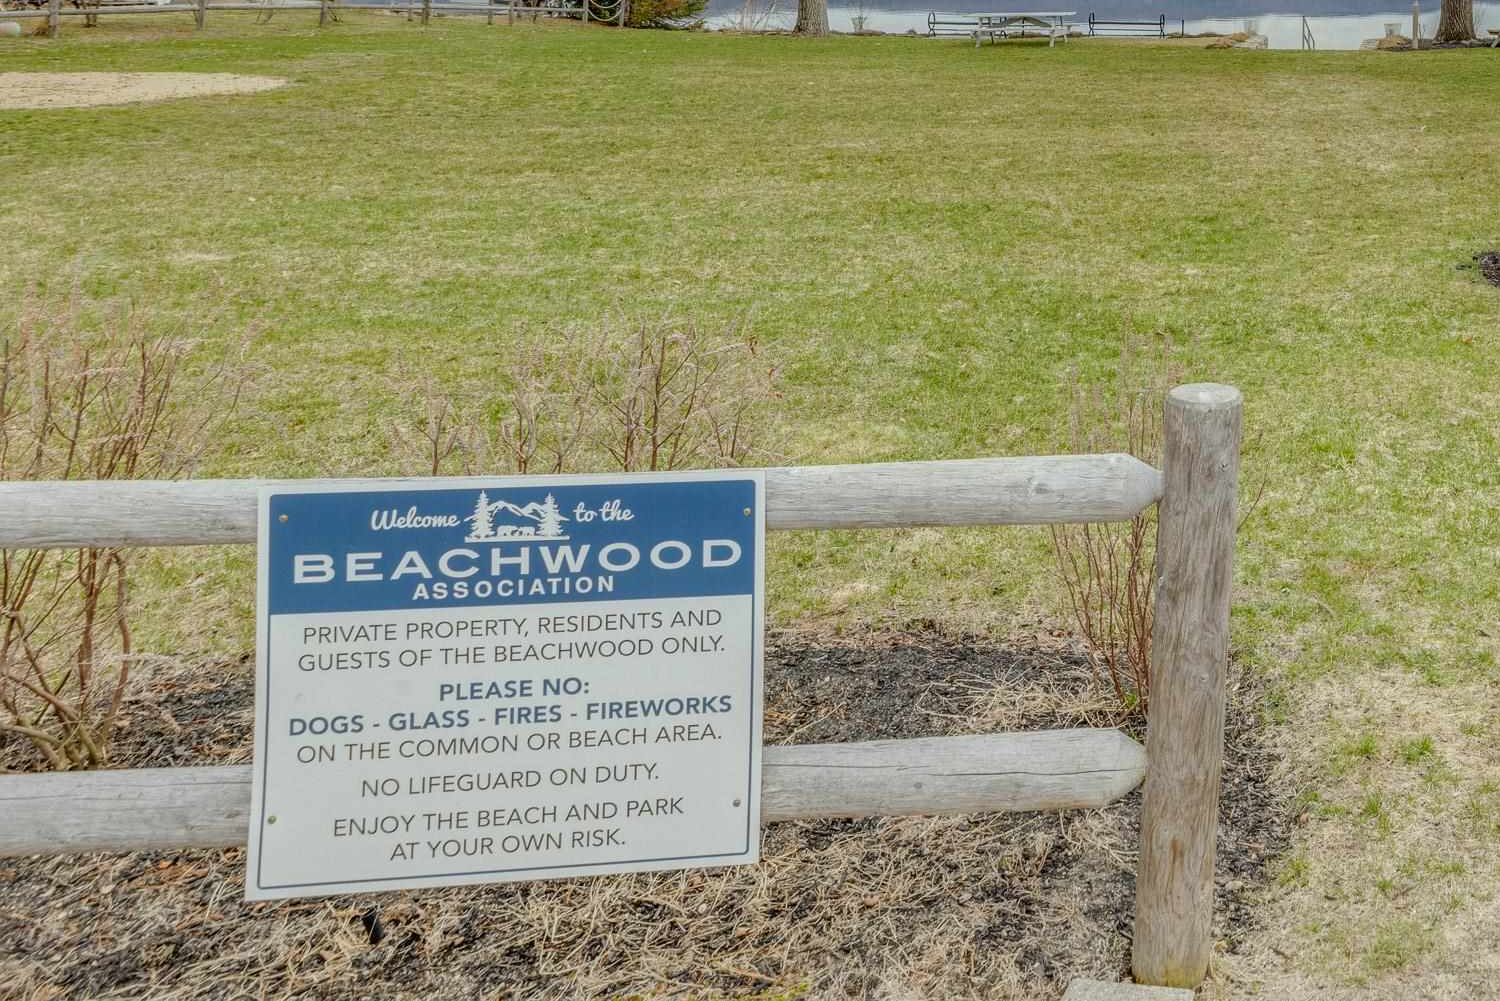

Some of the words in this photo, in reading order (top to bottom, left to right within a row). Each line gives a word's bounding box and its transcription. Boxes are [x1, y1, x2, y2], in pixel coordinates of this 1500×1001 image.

[371, 507, 461, 531] Welcome
[574, 503, 598, 522] to
[599, 500, 634, 522] the
[293, 539, 742, 584] BEACHWOOD
[413, 575, 614, 600] ASSOCIATION
[304, 624, 397, 644] PRIVATE
[406, 618, 529, 640] PROPERTY,
[538, 612, 663, 634] RESIDENTS
[671, 609, 721, 627] AND
[298, 651, 390, 672] GUESTS
[399, 649, 432, 667] OF
[440, 647, 485, 666] THE
[494, 638, 654, 663] BEACHWOOD
[662, 635, 725, 655] ONLY.
[440, 680, 533, 701] PLEASE
[543, 677, 589, 696] NO:
[289, 715, 363, 737] DOGS
[388, 709, 470, 732] GLASS
[495, 705, 562, 726] FIRES
[586, 696, 732, 720] FIREWORKS
[297, 745, 335, 764] ON
[344, 742, 391, 761] THE
[399, 735, 518, 758] COMMON
[527, 732, 561, 751] OR
[569, 728, 647, 748] BEACH
[656, 724, 721, 743] AREA.
[362, 778, 400, 797] NO
[409, 770, 541, 794] LIFEGUARD
[550, 767, 586, 785] ON
[595, 763, 659, 782] DUTY.
[334, 814, 415, 836] ENJOY
[423, 811, 469, 830] THE
[478, 805, 557, 827] BEACH
[565, 801, 618, 821] AND
[627, 797, 684, 817] PARK
[390, 841, 420, 860] AT
[427, 837, 493, 858] YOUR
[501, 832, 562, 853] OWN
[572, 829, 625, 848] RISK.
